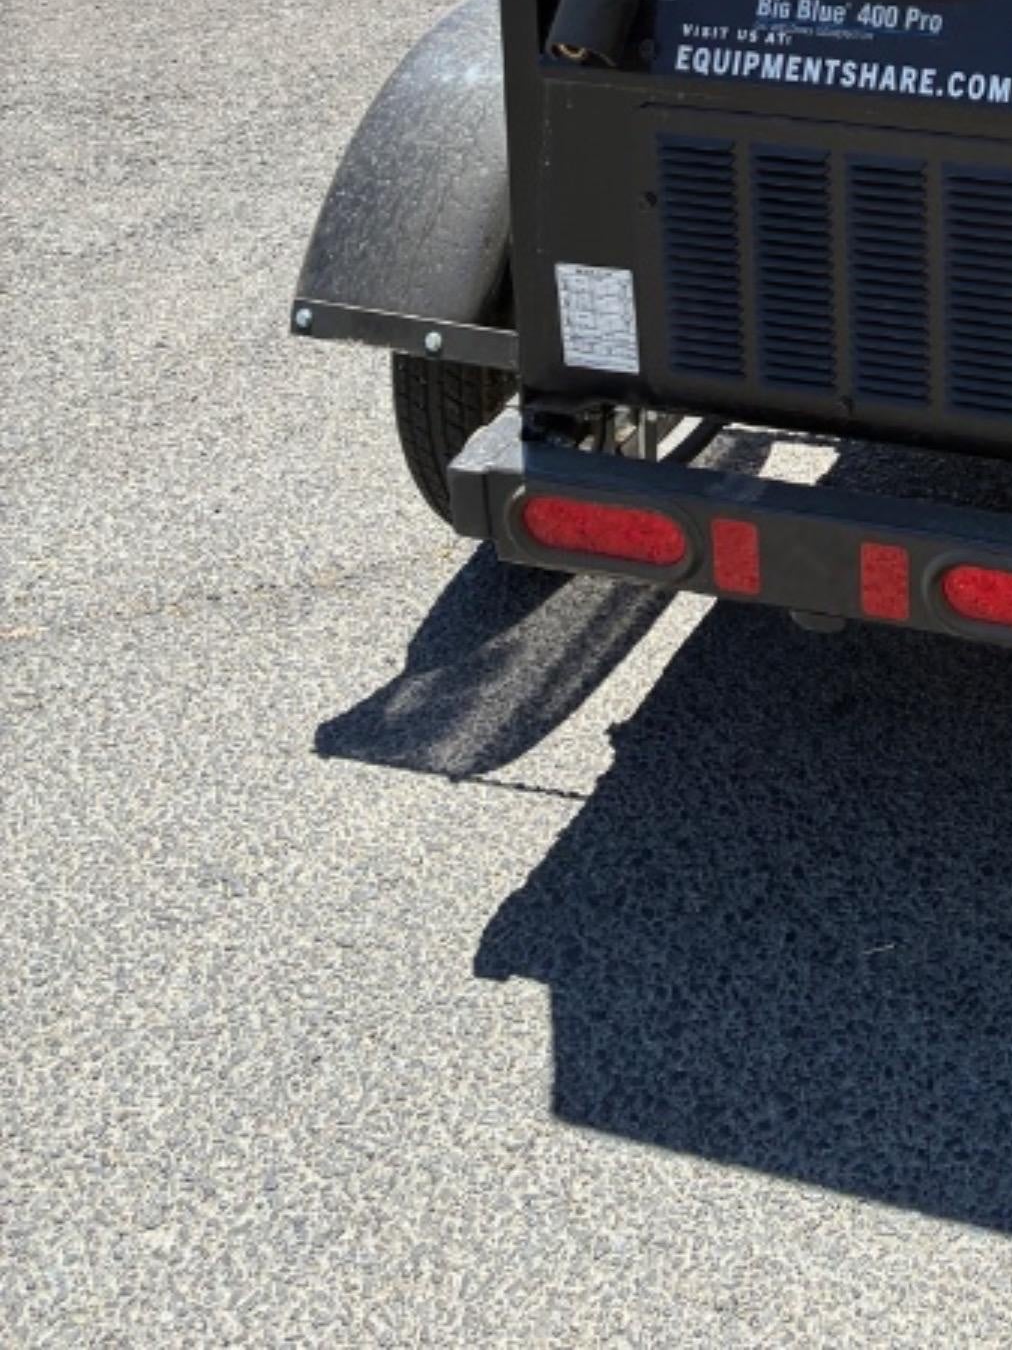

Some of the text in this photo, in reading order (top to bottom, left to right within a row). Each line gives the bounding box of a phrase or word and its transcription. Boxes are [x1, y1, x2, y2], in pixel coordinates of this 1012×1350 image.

[857, 2, 898, 29] 400
[904, 7, 943, 34] Pro
[682, 23, 730, 40] VISIT
[736, 28, 758, 43] US
[764, 30, 792, 46] AT:
[674, 44, 1012, 104] EQUIPMENTSHARE.COM
